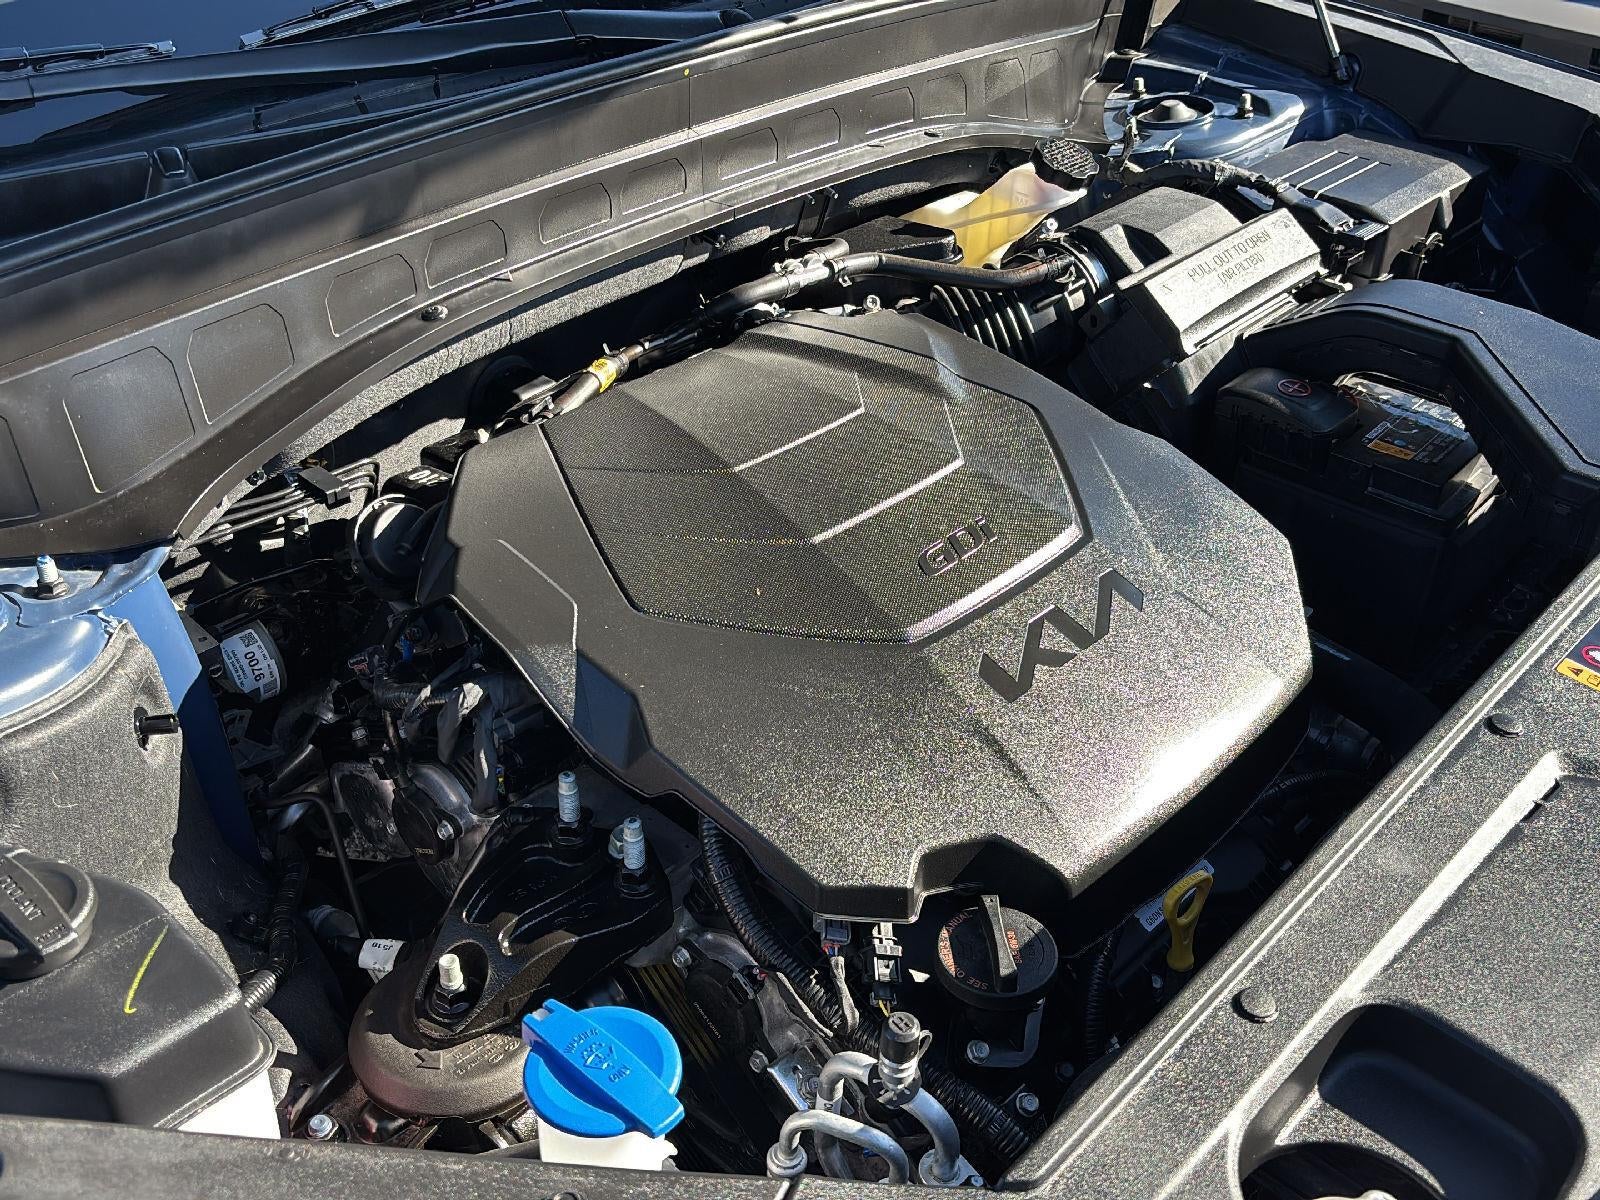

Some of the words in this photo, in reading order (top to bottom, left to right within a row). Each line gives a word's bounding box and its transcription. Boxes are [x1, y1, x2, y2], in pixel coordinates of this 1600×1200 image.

[1187, 261, 1217, 282] PULL
[1212, 248, 1234, 268] OUT
[1233, 242, 1249, 256] TO
[1246, 229, 1272, 250] OPEN
[244, 651, 265, 682] 9700
[966, 976, 988, 990] SEE
